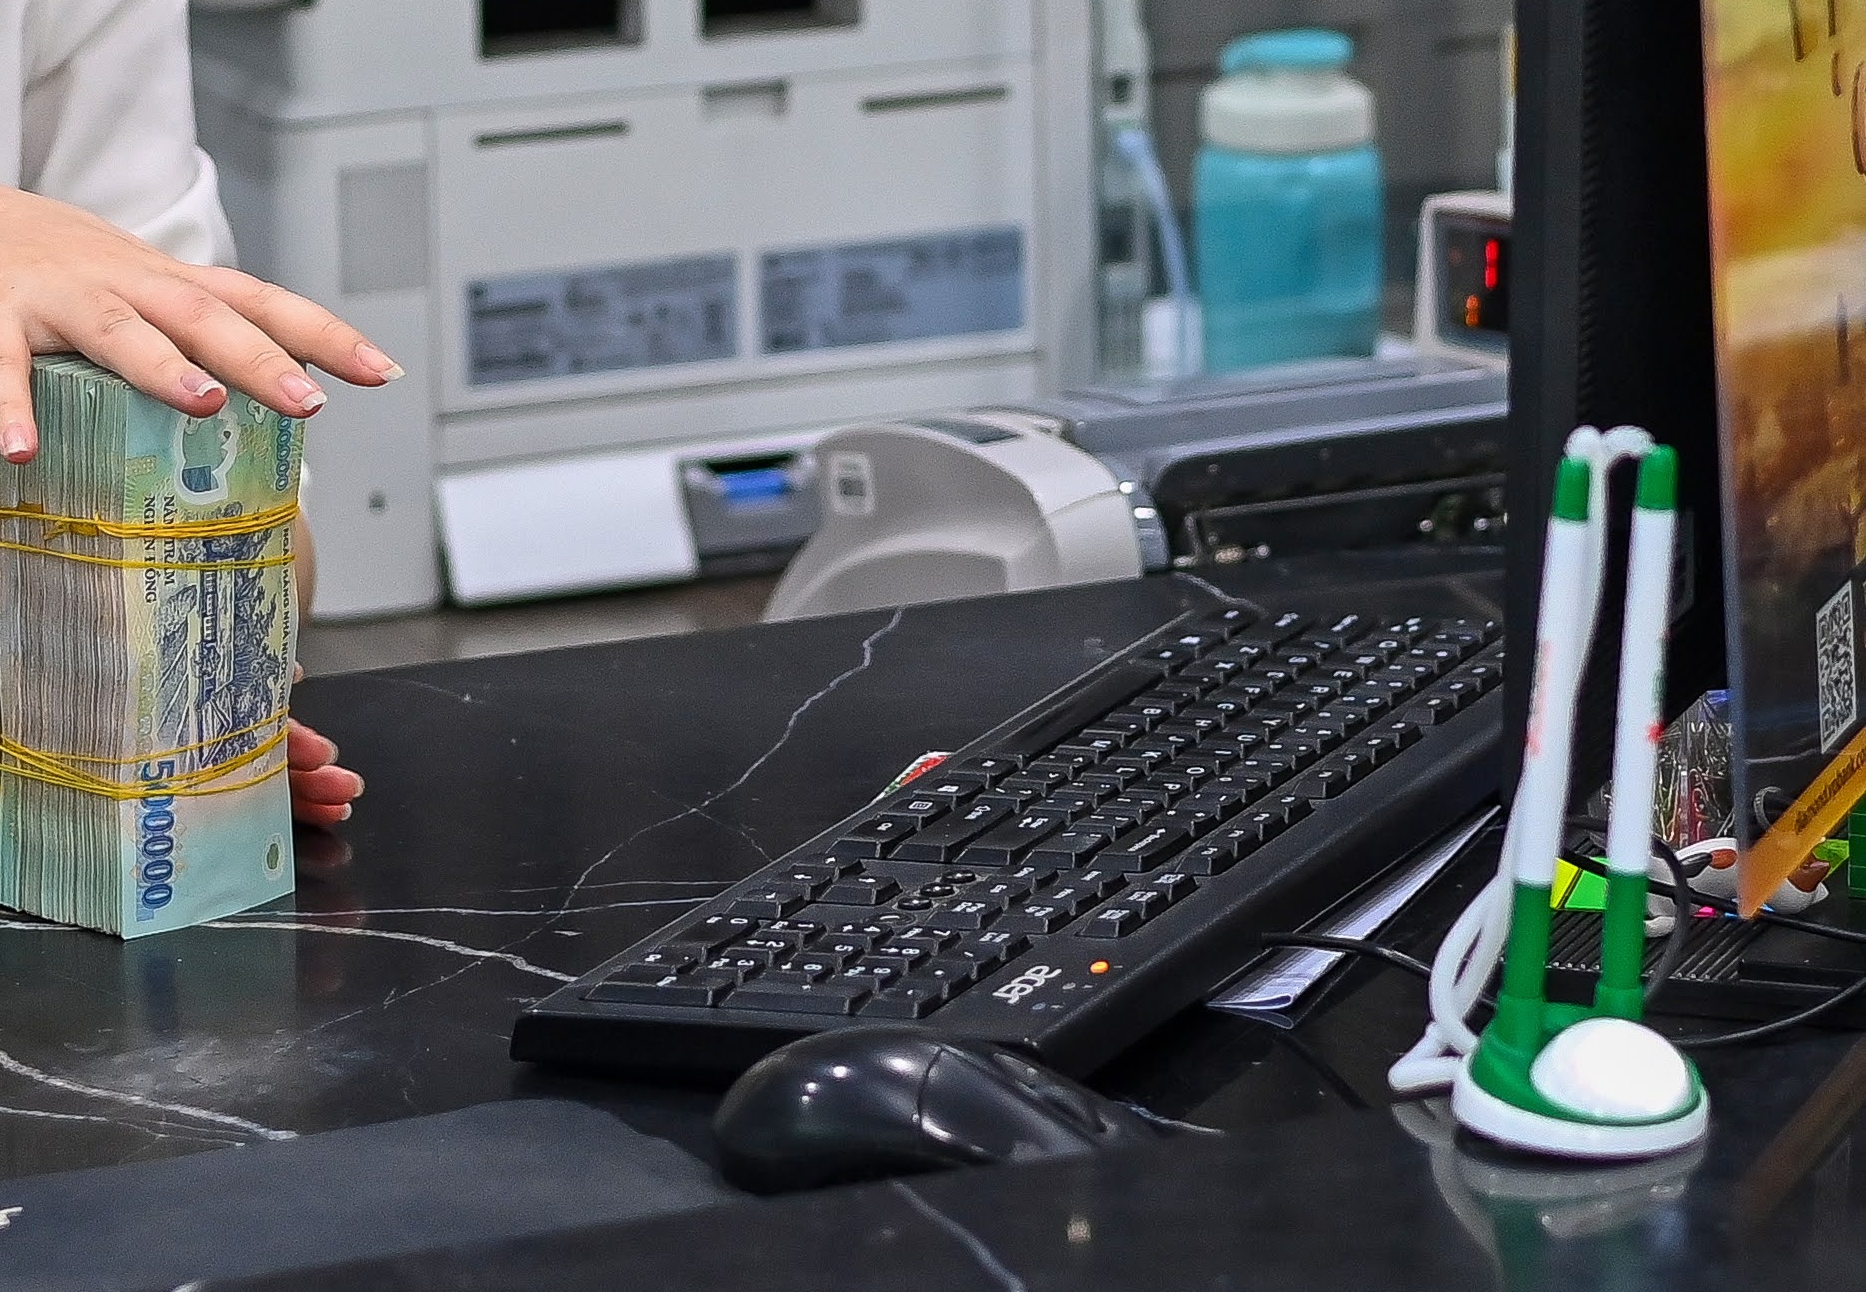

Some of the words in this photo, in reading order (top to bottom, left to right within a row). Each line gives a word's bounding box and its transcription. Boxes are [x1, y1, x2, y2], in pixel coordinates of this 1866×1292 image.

[275, 415, 292, 492] 00000
[163, 537, 177, 586] TRM
[140, 760, 176, 910] 500000
[991, 964, 1065, 1005] acer
